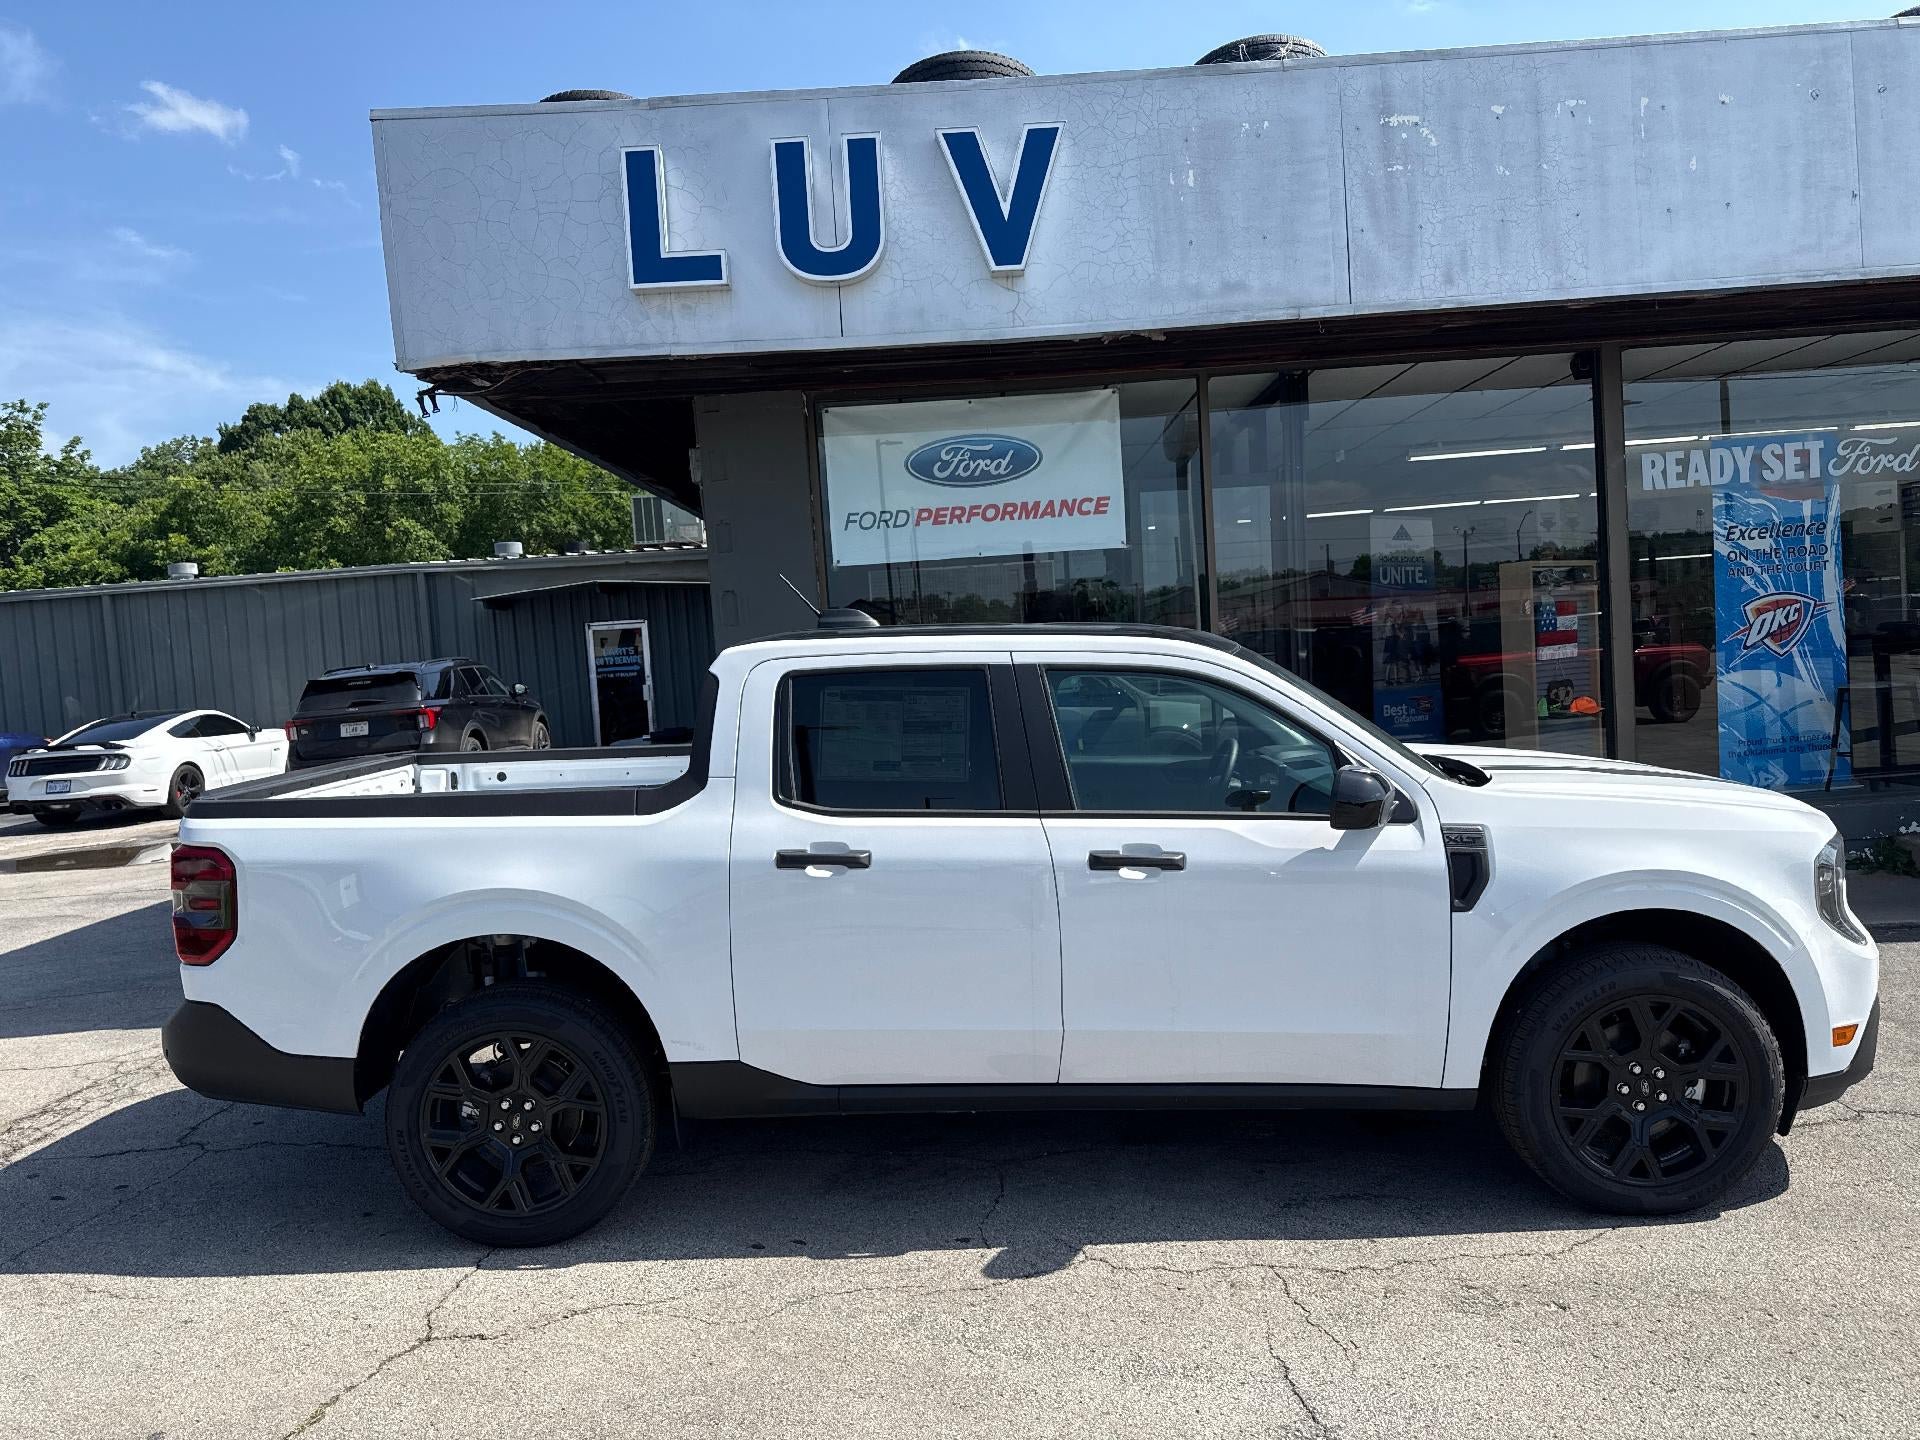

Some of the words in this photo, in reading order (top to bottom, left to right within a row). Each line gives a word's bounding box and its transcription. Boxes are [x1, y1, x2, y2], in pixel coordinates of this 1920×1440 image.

[620, 120, 1067, 293] LUV
[933, 443, 1013, 479] Ford
[1641, 445, 1755, 491] READY
[1760, 440, 1825, 482] SET
[1828, 437, 1920, 477] Ford
[844, 509, 910, 531] FORD
[914, 496, 1111, 527] PERFORMANCE
[1725, 520, 1827, 542] Excellence
[1727, 550, 1749, 562] ON
[1753, 547, 1782, 560] THE
[1787, 543, 1829, 558] ROAD
[1379, 566, 1428, 584] UNITE.
[1727, 566, 1755, 578] AND
[1758, 563, 1783, 576] THE
[1787, 560, 1829, 573] COURT
[1745, 602, 1801, 647] OKC
[1383, 703, 1408, 717] Best
[1738, 739, 1763, 747] Proud
[1764, 735, 1787, 744] Truck
[1789, 733, 1821, 743] Partner
[1728, 751, 1742, 759] the
[1743, 746, 1787, 758] Oklahoma
[1789, 744, 1806, 755] City
[1808, 742, 1842, 752] Thundr
